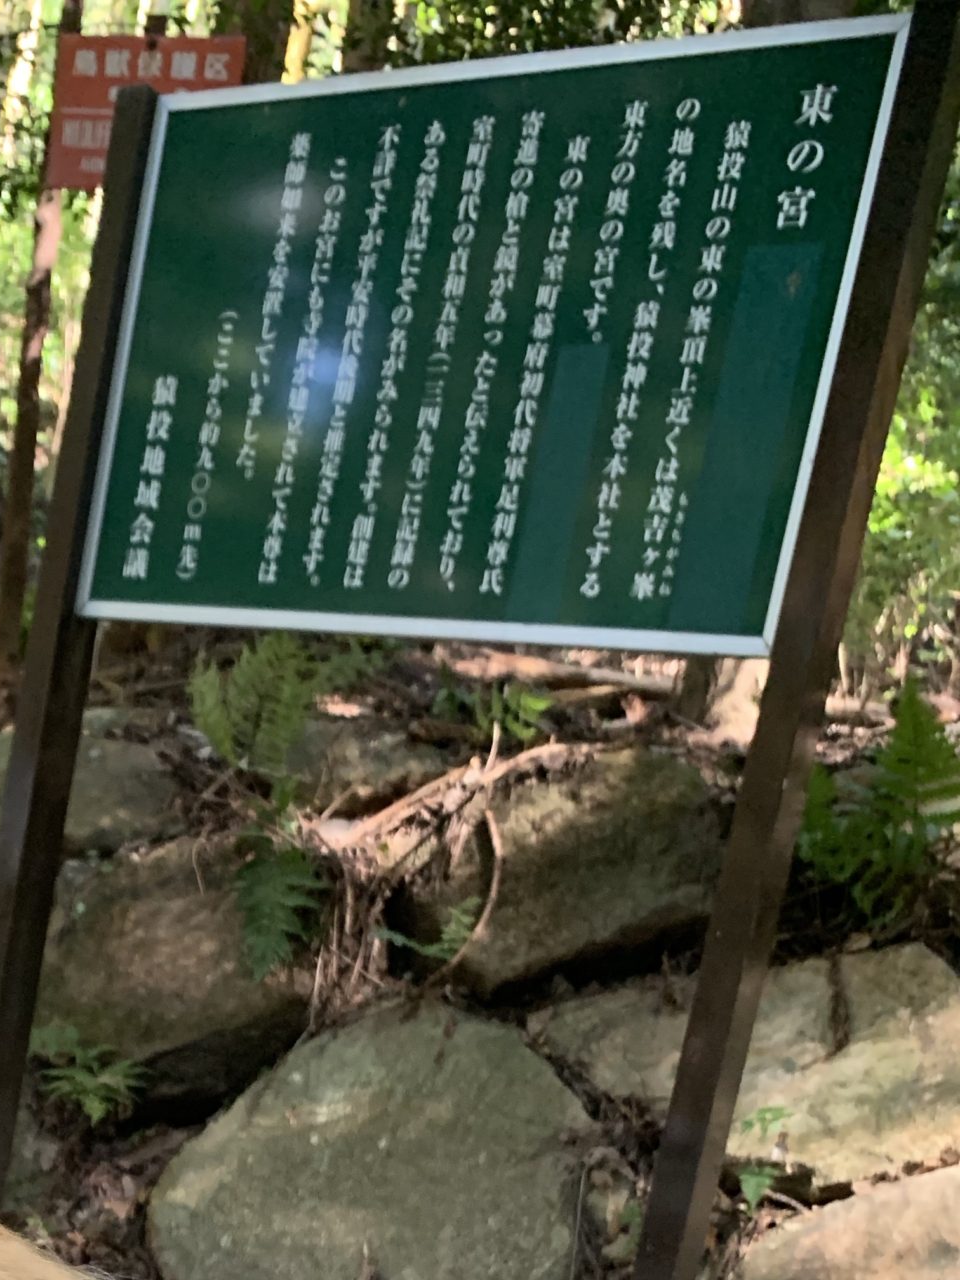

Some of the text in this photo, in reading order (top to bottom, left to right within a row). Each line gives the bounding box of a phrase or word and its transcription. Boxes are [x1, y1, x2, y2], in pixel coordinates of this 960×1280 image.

[583, 100, 650, 345] 東方の奥の宮です。
[777, 83, 840, 231] 東の宮
[479, 135, 592, 597] 東の宮は室町幕府初代将軍足利尊氏
[580, 98, 703, 600] の地名を残し、猿投神社を本社とする
[123, 375, 180, 581] 猿投地域会議
